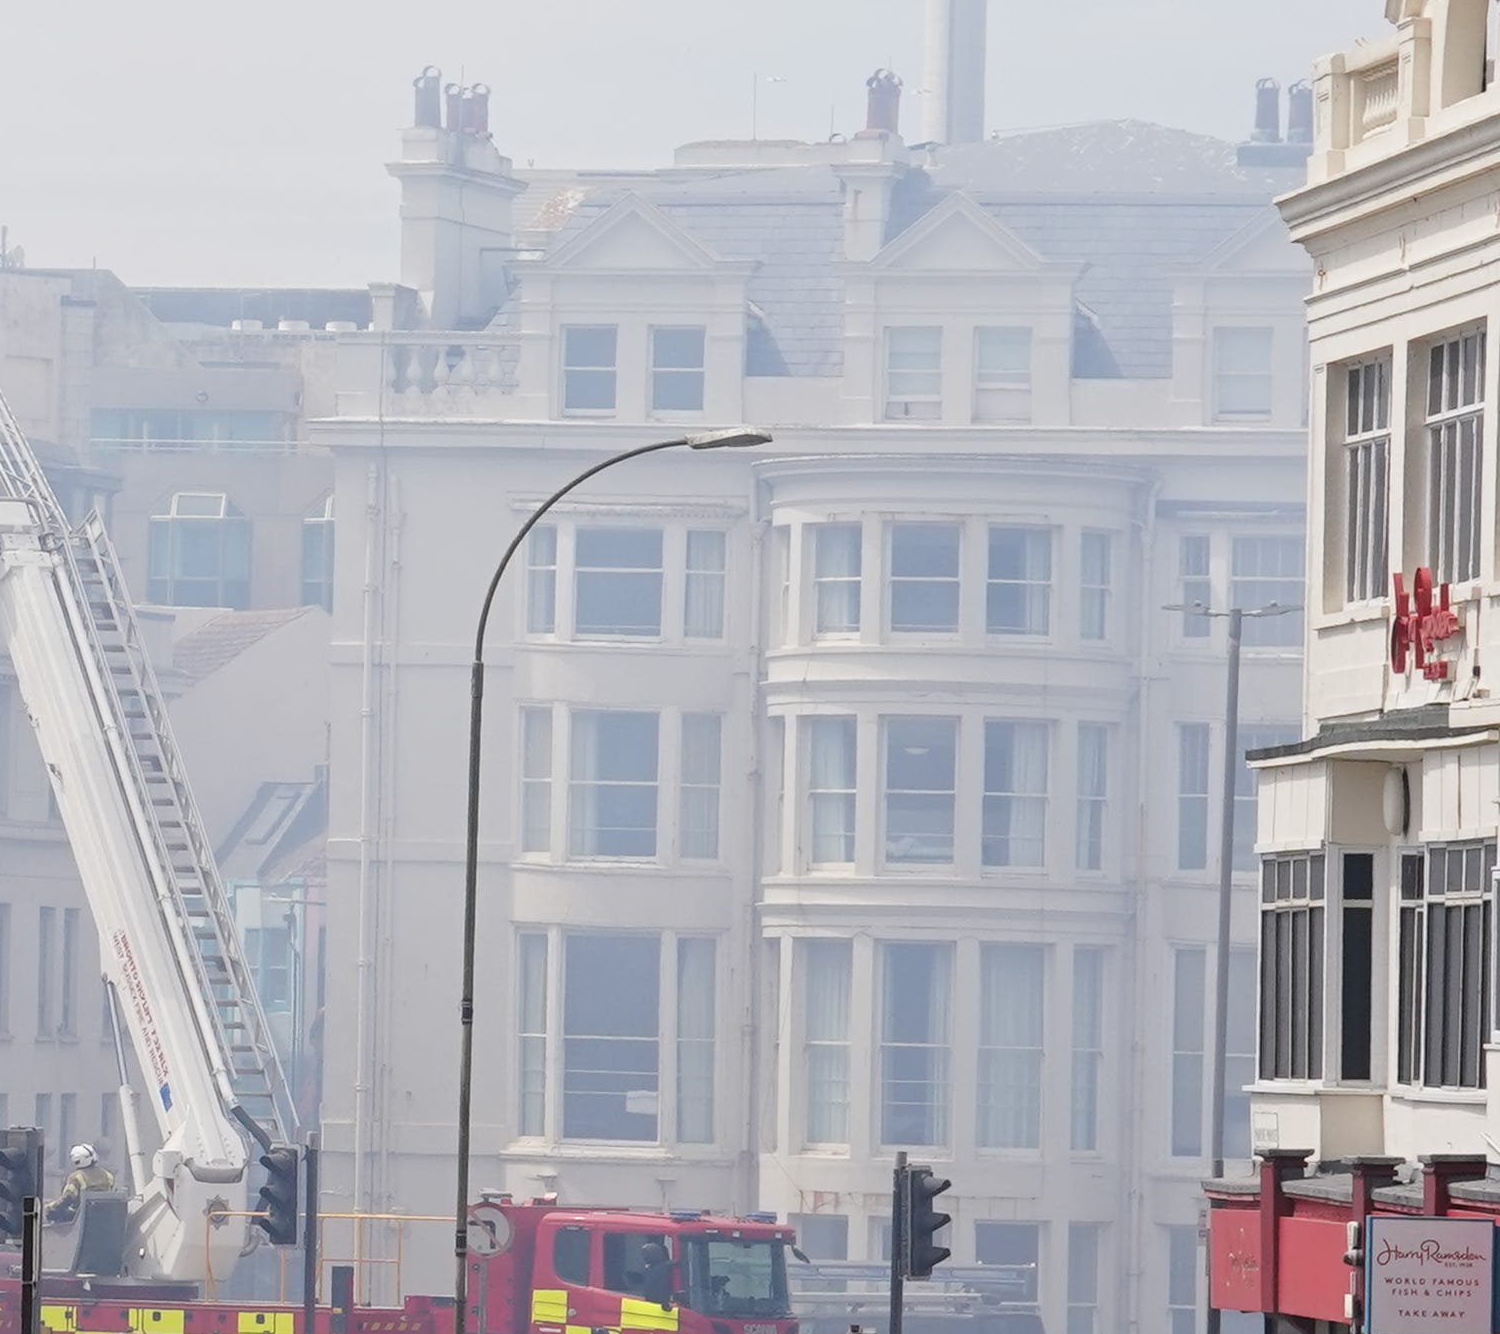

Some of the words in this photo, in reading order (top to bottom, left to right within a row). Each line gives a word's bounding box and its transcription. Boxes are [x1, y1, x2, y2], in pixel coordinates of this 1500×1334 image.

[1377, 1238, 1424, 1266] Harry
[1384, 1277, 1426, 1286] WORLD
[1432, 1278, 1480, 1287] FAMOUS
[1391, 1288, 1418, 1297] FISH
[1423, 1289, 1430, 1297] &
[1436, 1289, 1473, 1298] CHIPS
[1398, 1309, 1428, 1318] TAKE
[1432, 1310, 1466, 1318] AWAY
